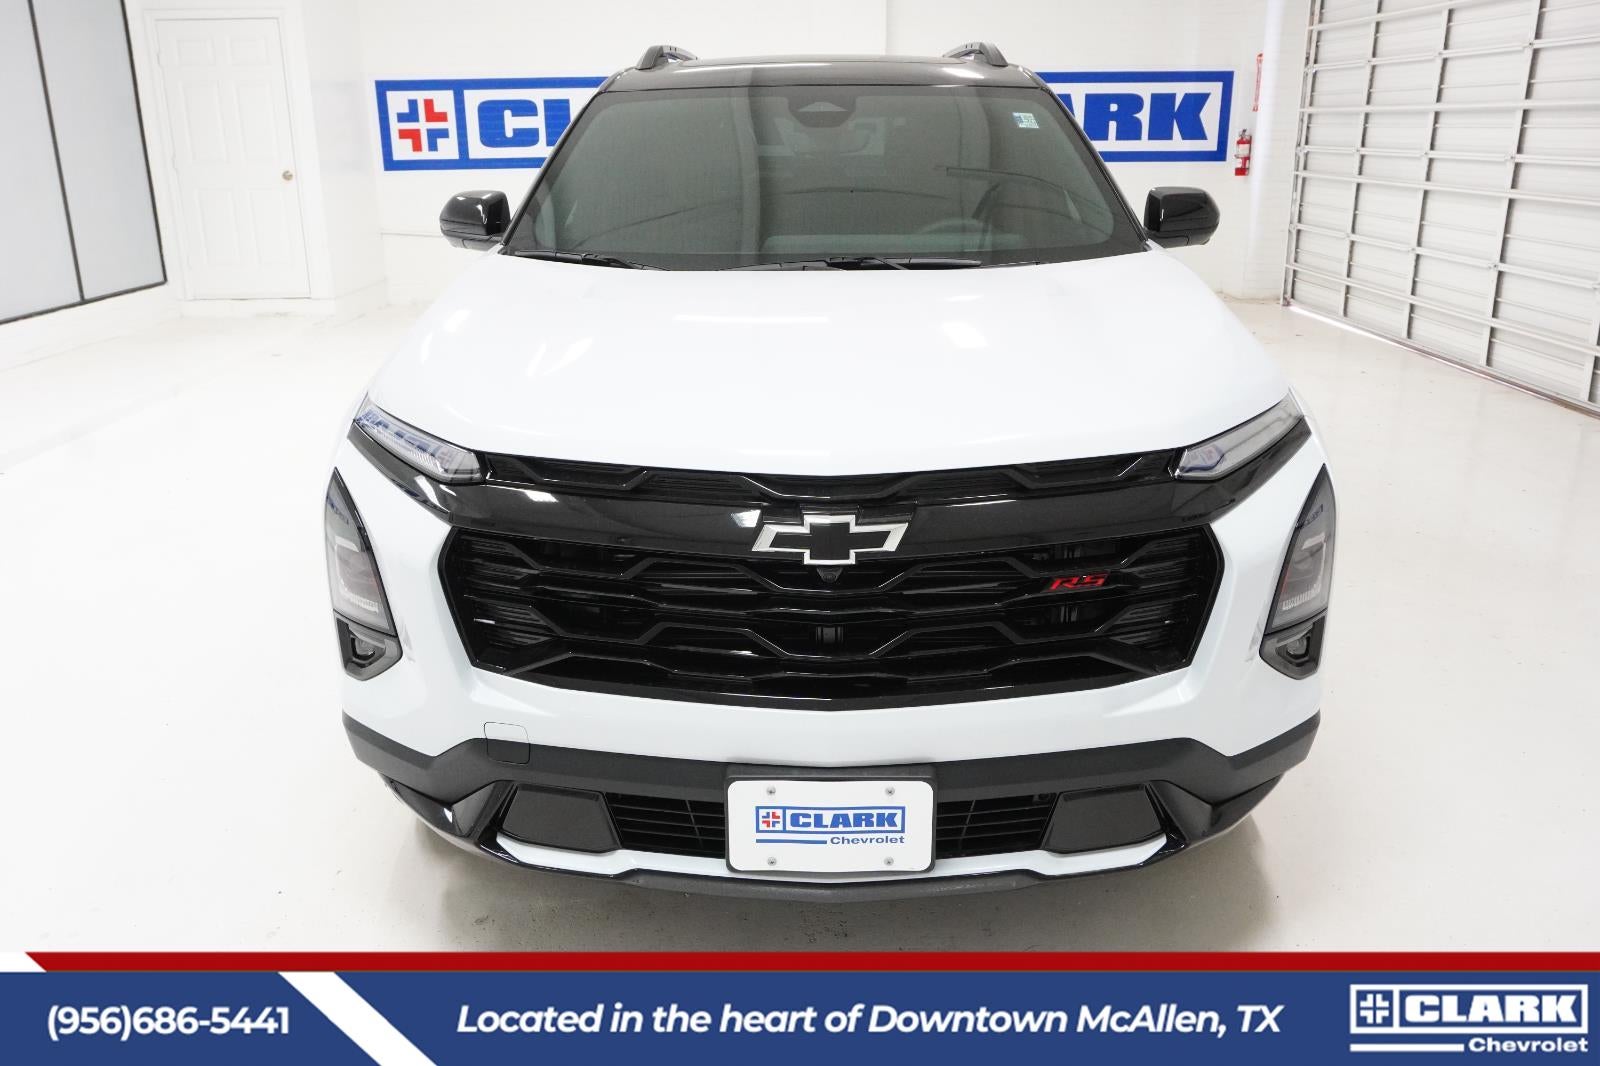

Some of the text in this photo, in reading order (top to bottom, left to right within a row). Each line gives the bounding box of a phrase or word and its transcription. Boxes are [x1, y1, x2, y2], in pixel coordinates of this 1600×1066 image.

[1048, 573, 1109, 592] RS
[790, 812, 899, 829] CLARK
[829, 835, 905, 846] Chevrolet
